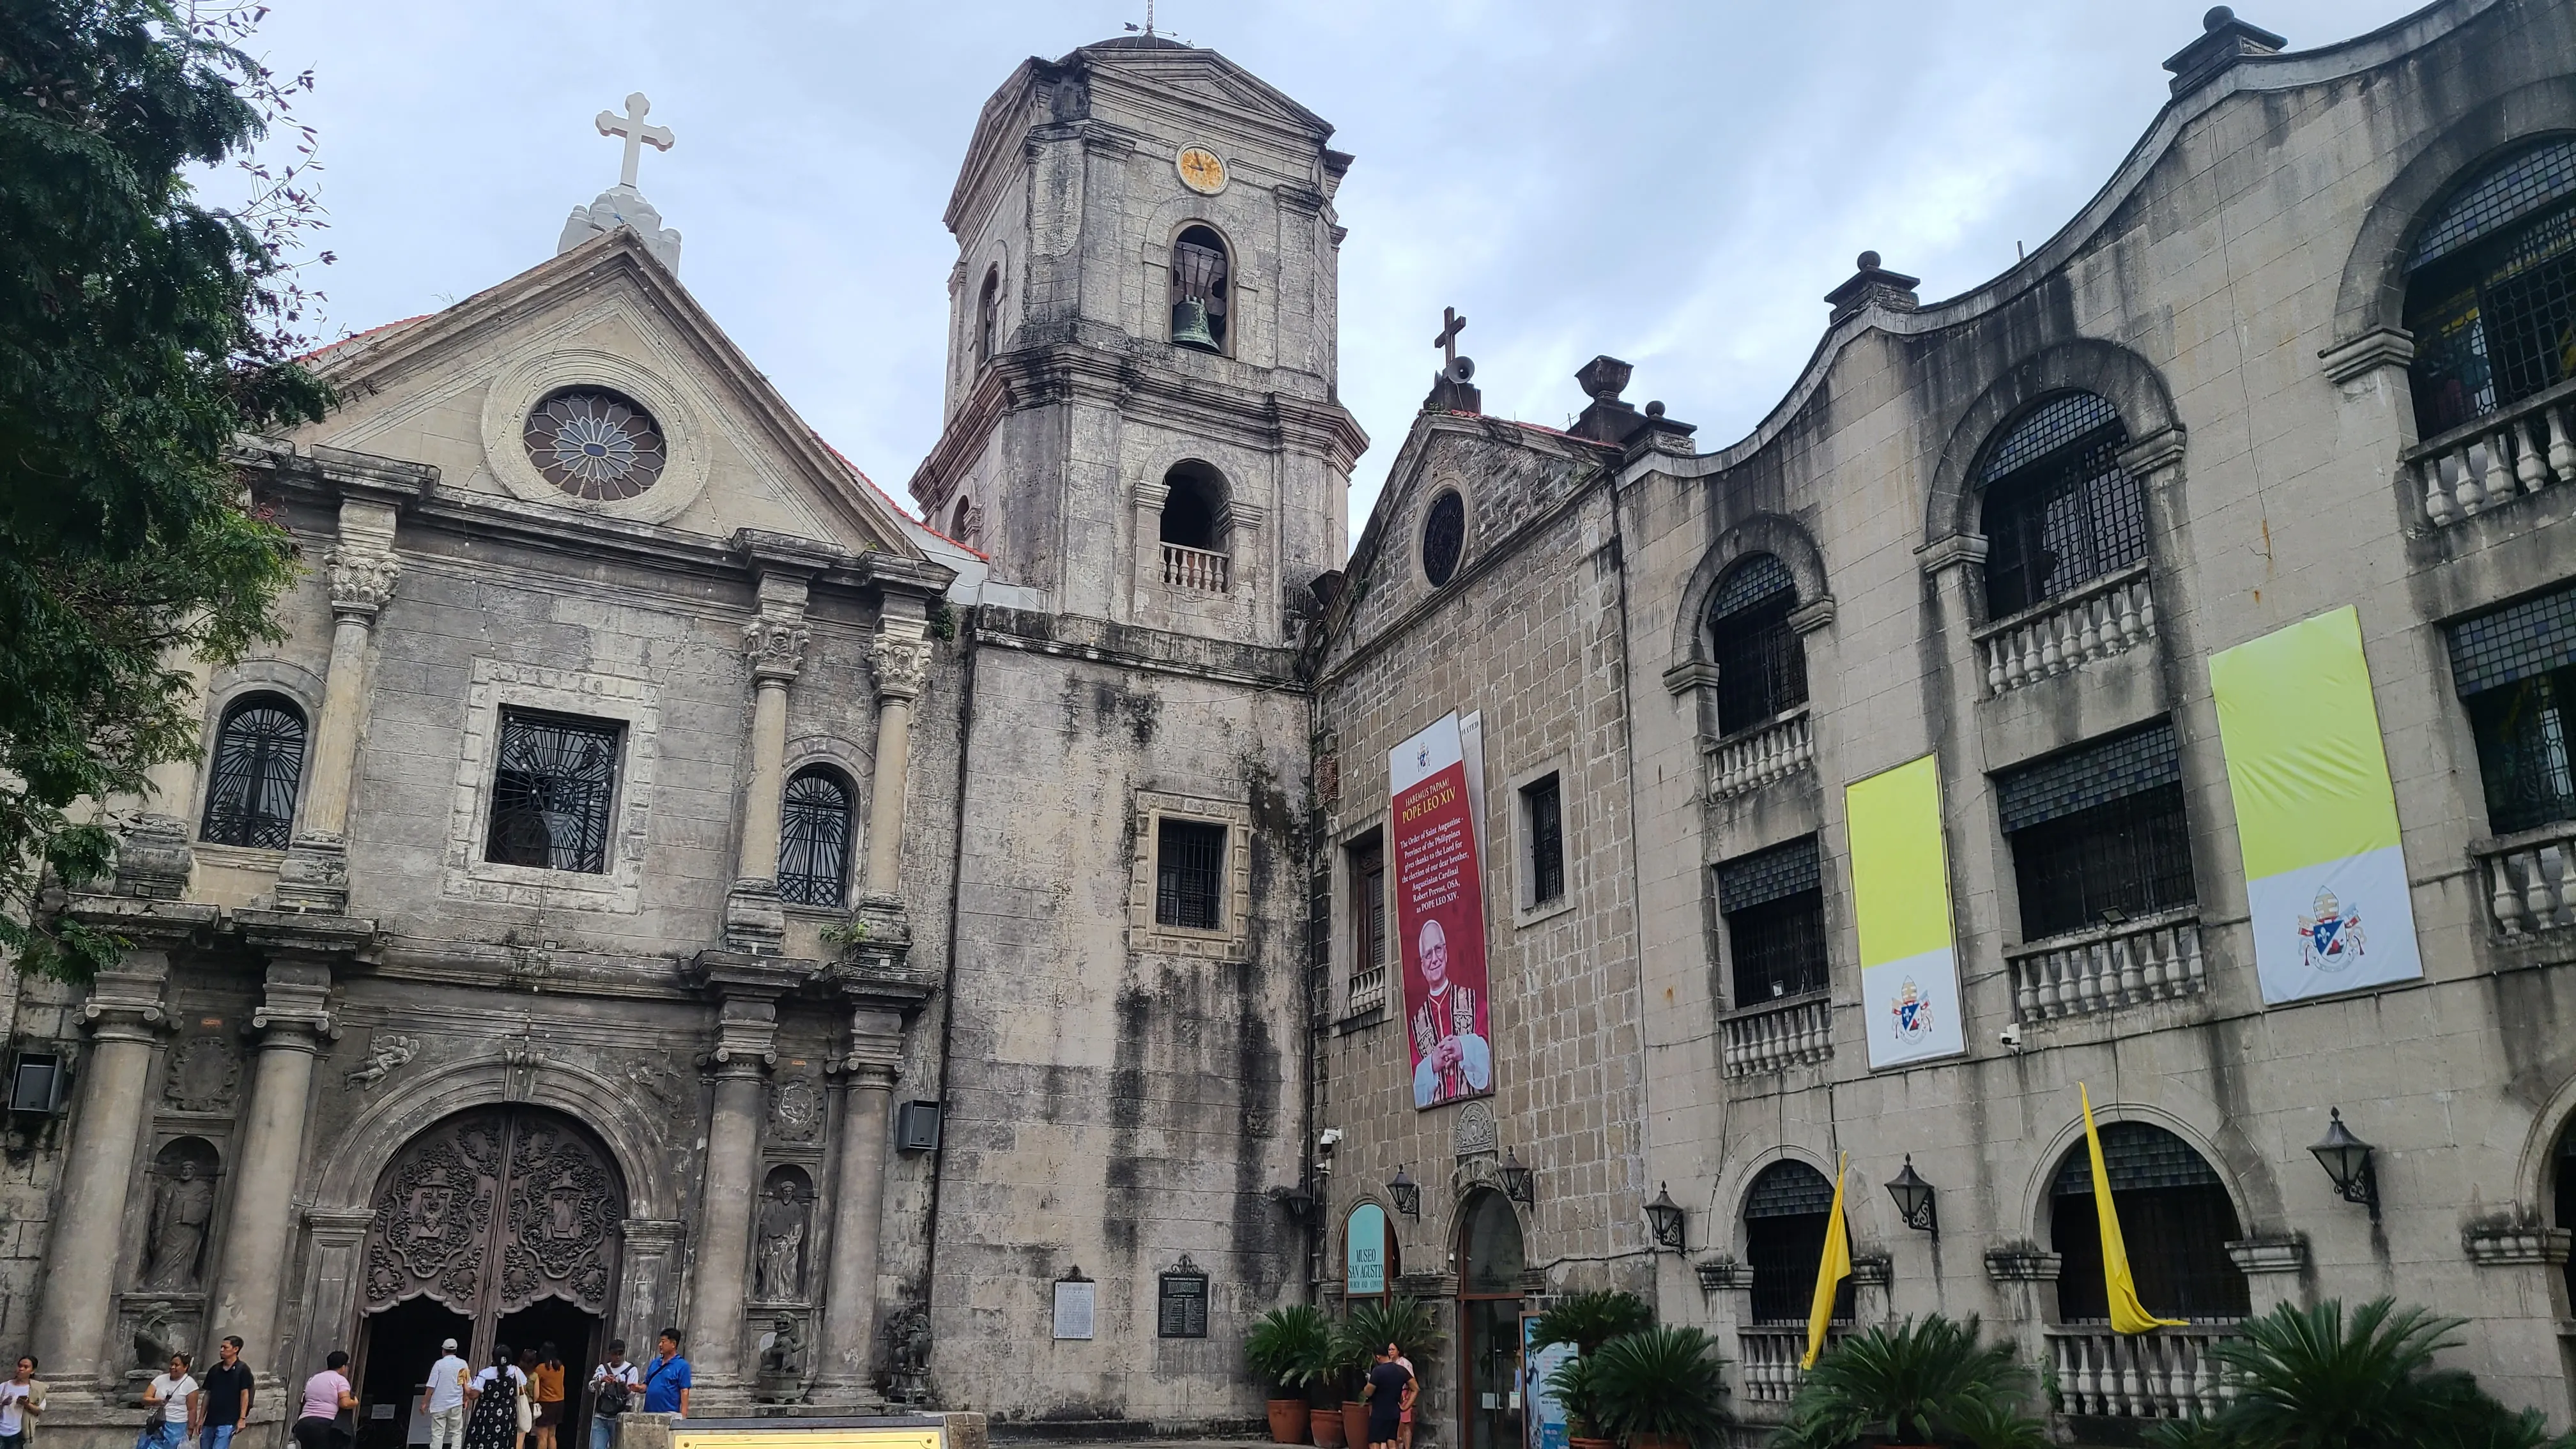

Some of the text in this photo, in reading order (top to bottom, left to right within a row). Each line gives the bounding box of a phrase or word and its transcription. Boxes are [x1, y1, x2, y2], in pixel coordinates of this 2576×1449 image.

[1402, 786, 1455, 824] POPE LEO XIV
[1406, 777, 1449, 808] HABEMUS PAPAM!
[1404, 847, 1422, 859] Province
[1422, 841, 1427, 850] of
[1435, 830, 1460, 846] Philippines
[1408, 834, 1420, 845] Order
[1420, 831, 1425, 839] of
[1425, 827, 1436, 837] Saint
[1438, 818, 1460, 832] Augustine
[1405, 862, 1414, 873] gives
[1414, 854, 1429, 866] thanks
[1443, 843, 1454, 854] Lord
[1409, 869, 1425, 880] election
[1425, 864, 1430, 873] of
[1439, 859, 1449, 868] dear
[1449, 852, 1469, 864] brother,
[1412, 865, 1459, 891] Augustinian Cardinal
[1413, 878, 1460, 903] Robert Prevost, OSA,
[1421, 899, 1436, 912] POPE
[1436, 895, 1446, 906] LEO
[1446, 891, 1459, 903] XIV.
[1356, 1248, 1376, 1262] MUSEO
[1348, 1264, 1384, 1278] SAN AGUSTIN
